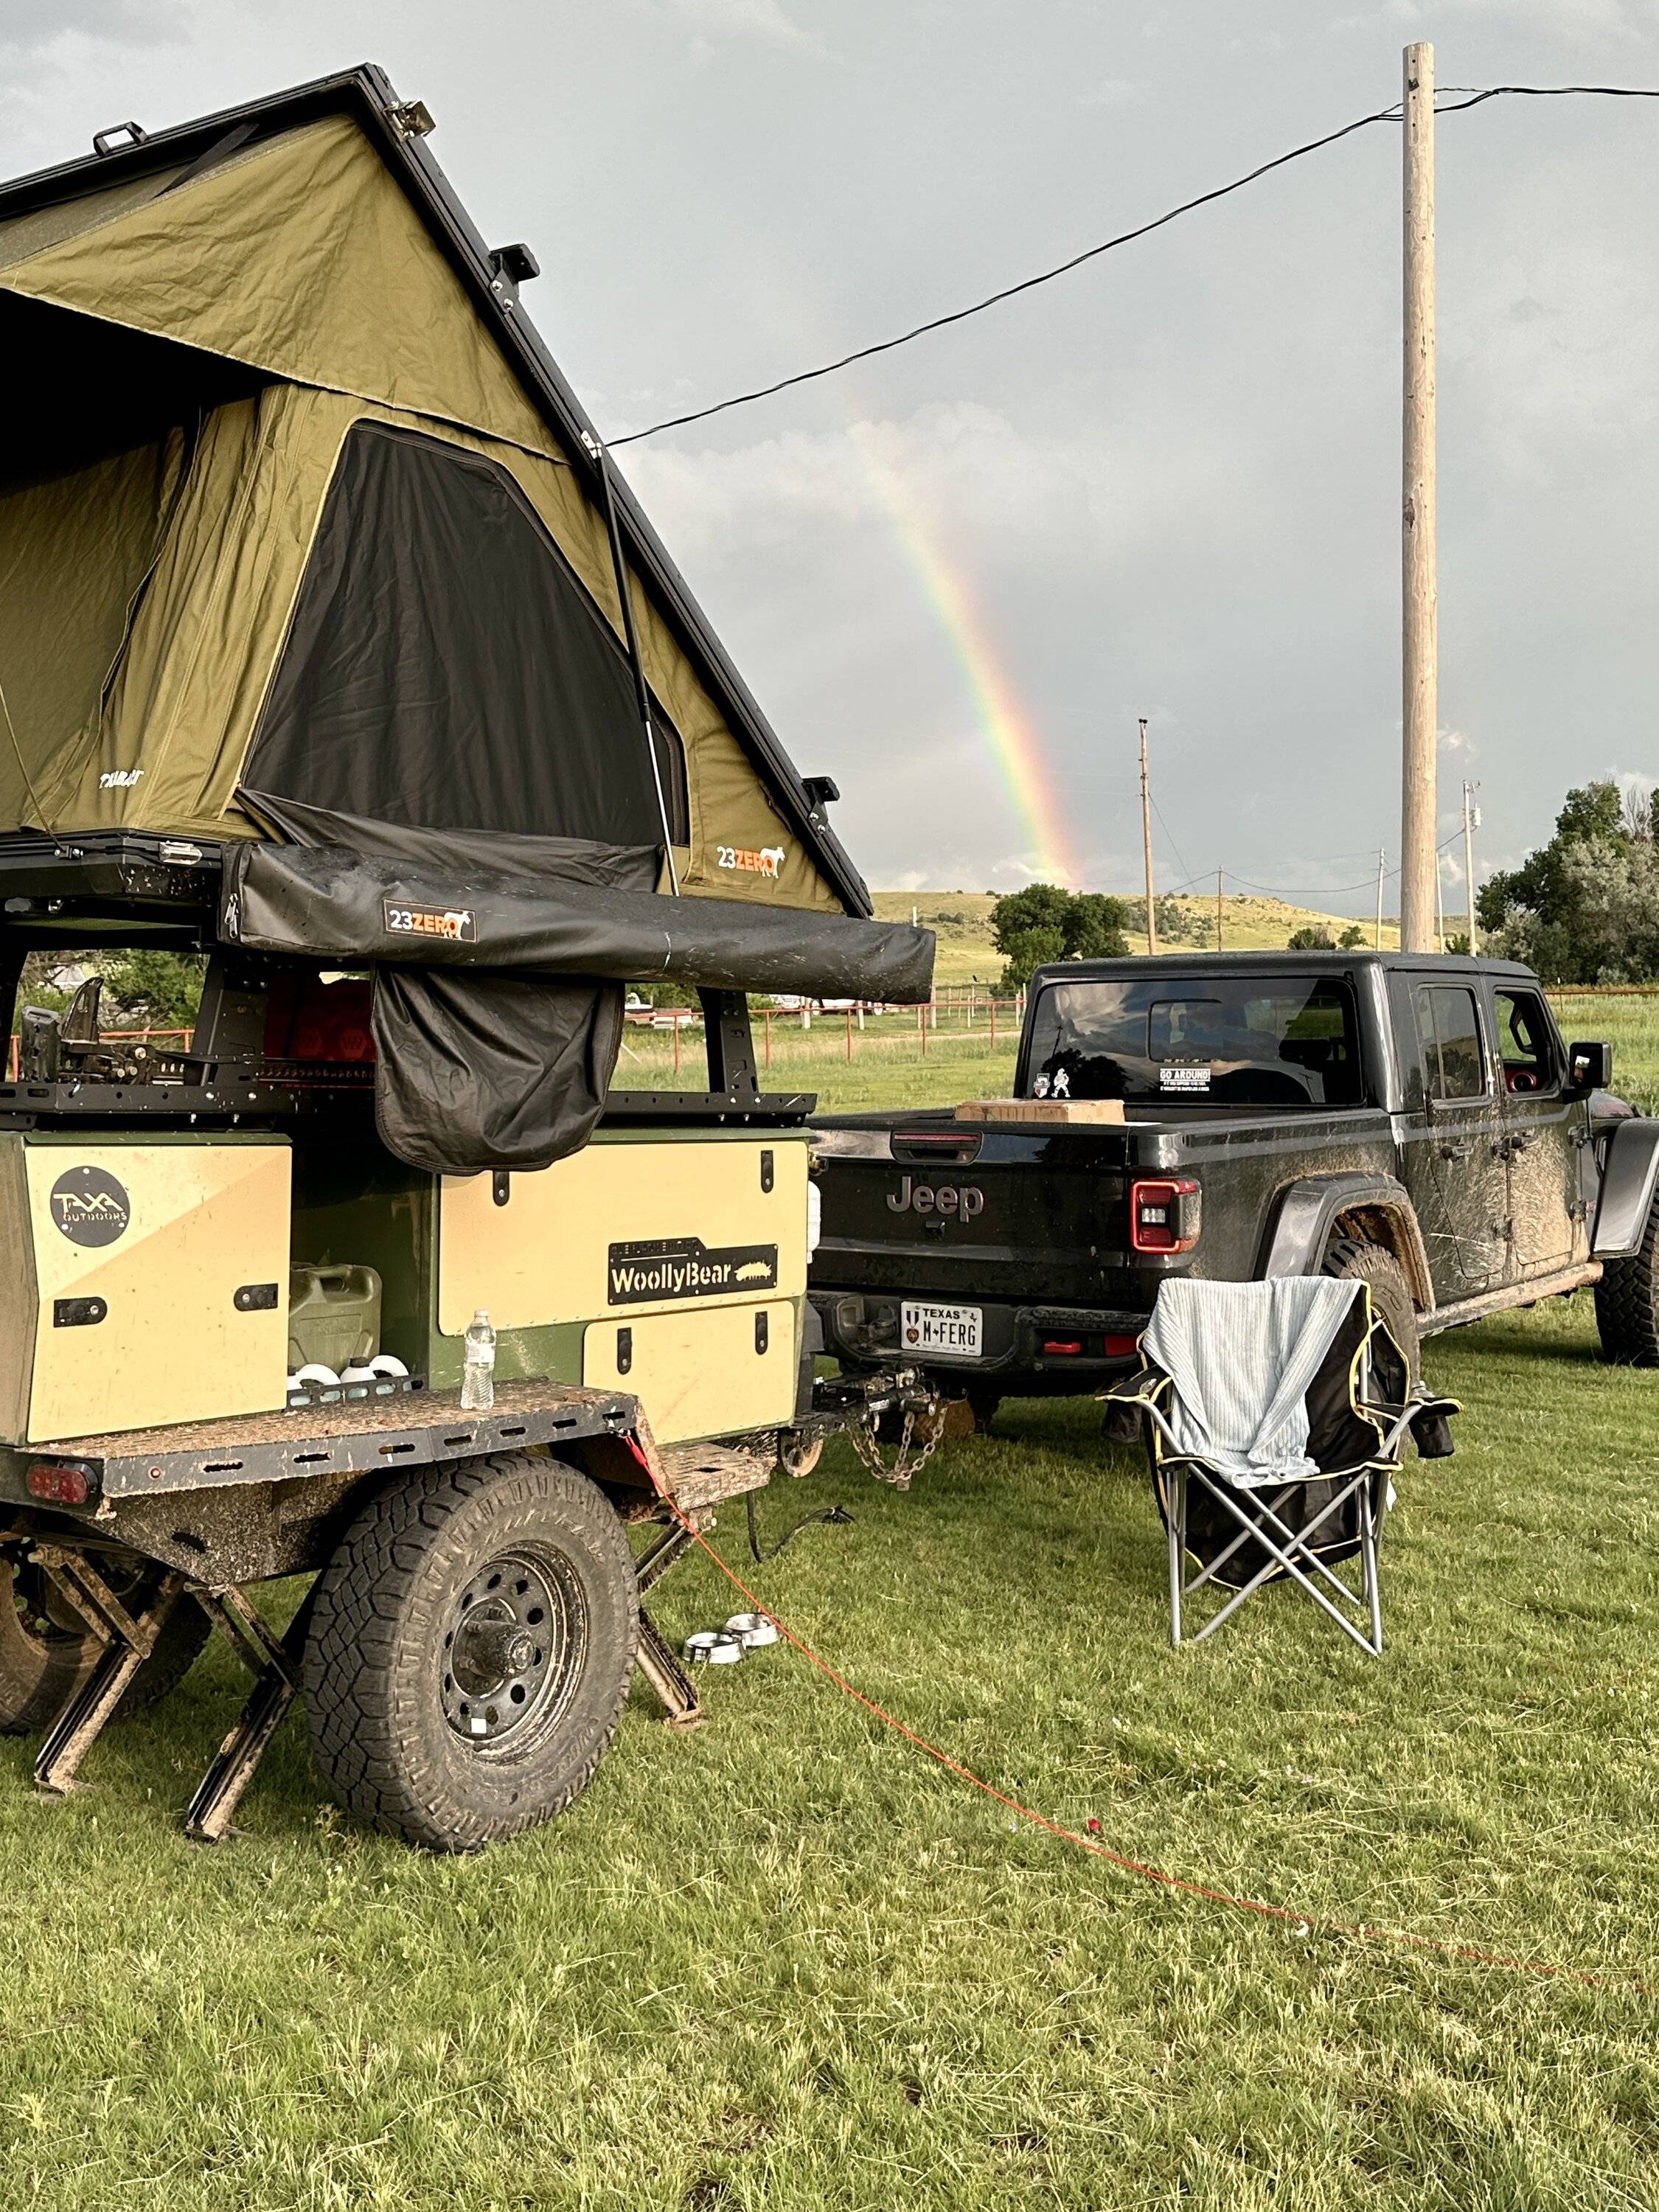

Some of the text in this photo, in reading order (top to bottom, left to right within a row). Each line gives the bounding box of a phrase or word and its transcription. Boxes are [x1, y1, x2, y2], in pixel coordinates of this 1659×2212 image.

[717, 846, 774, 874] 23ZERO
[389, 910, 458, 935] 23ZERO
[1160, 1071, 1172, 1079] GO
[53, 1192, 124, 1213] TAXA
[886, 1176, 984, 1223] Jeep
[63, 1211, 128, 1222] OUTDOORS
[611, 1262, 732, 1293] WoollyBear
[922, 1308, 961, 1320] TEXAS
